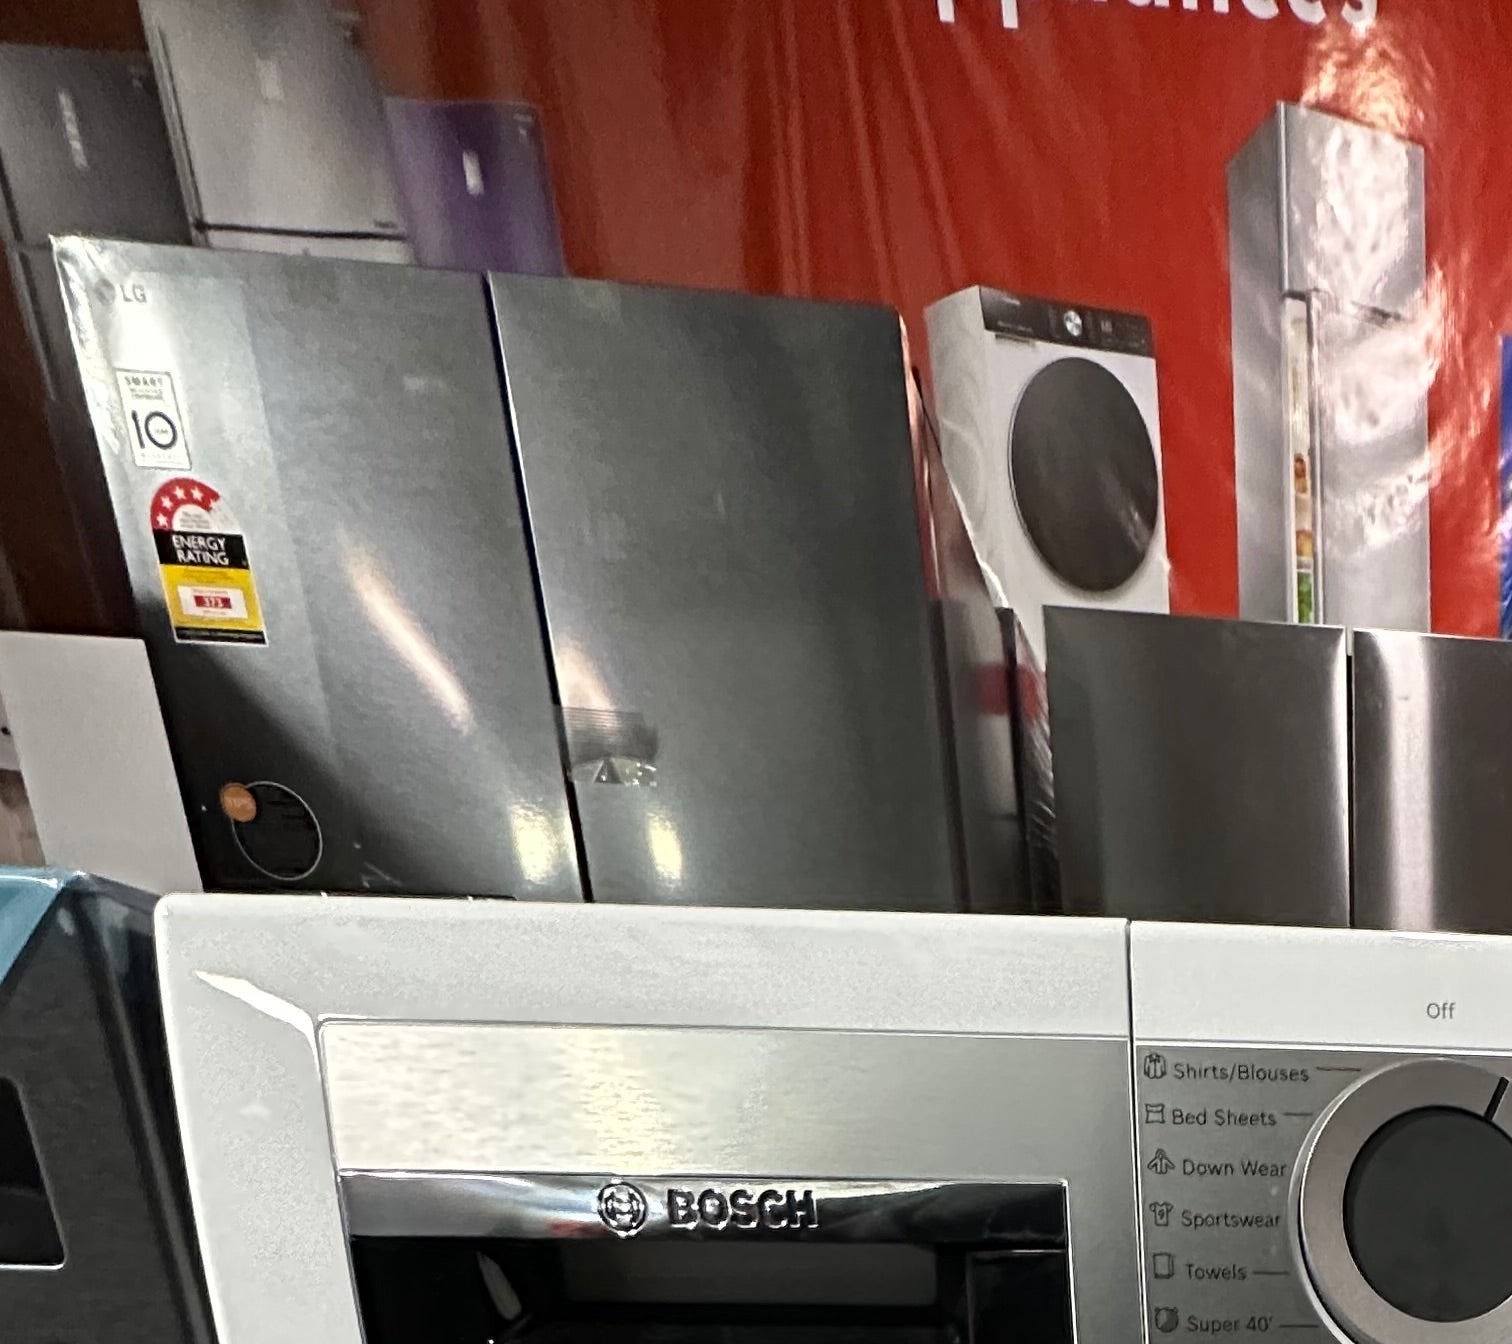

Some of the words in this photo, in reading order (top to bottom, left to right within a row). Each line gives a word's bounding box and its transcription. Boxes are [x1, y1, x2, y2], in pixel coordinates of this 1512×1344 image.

[120, 284, 147, 303] LG
[131, 410, 177, 450] 10
[171, 534, 226, 551] ENERGY
[176, 551, 230, 566] RATING
[1426, 1002, 1457, 1020] Off
[1173, 1062, 1310, 1083] Shirts/Blouses
[1172, 1108, 1207, 1126] Bed
[1214, 1108, 1277, 1126] Sheets
[1182, 1158, 1234, 1176] Down
[1241, 1159, 1287, 1177] Wear
[666, 1188, 820, 1229] BOSCH
[1181, 1209, 1281, 1231] Sportswear
[1186, 1263, 1247, 1281] Towels
[1187, 1315, 1240, 1335] Super
